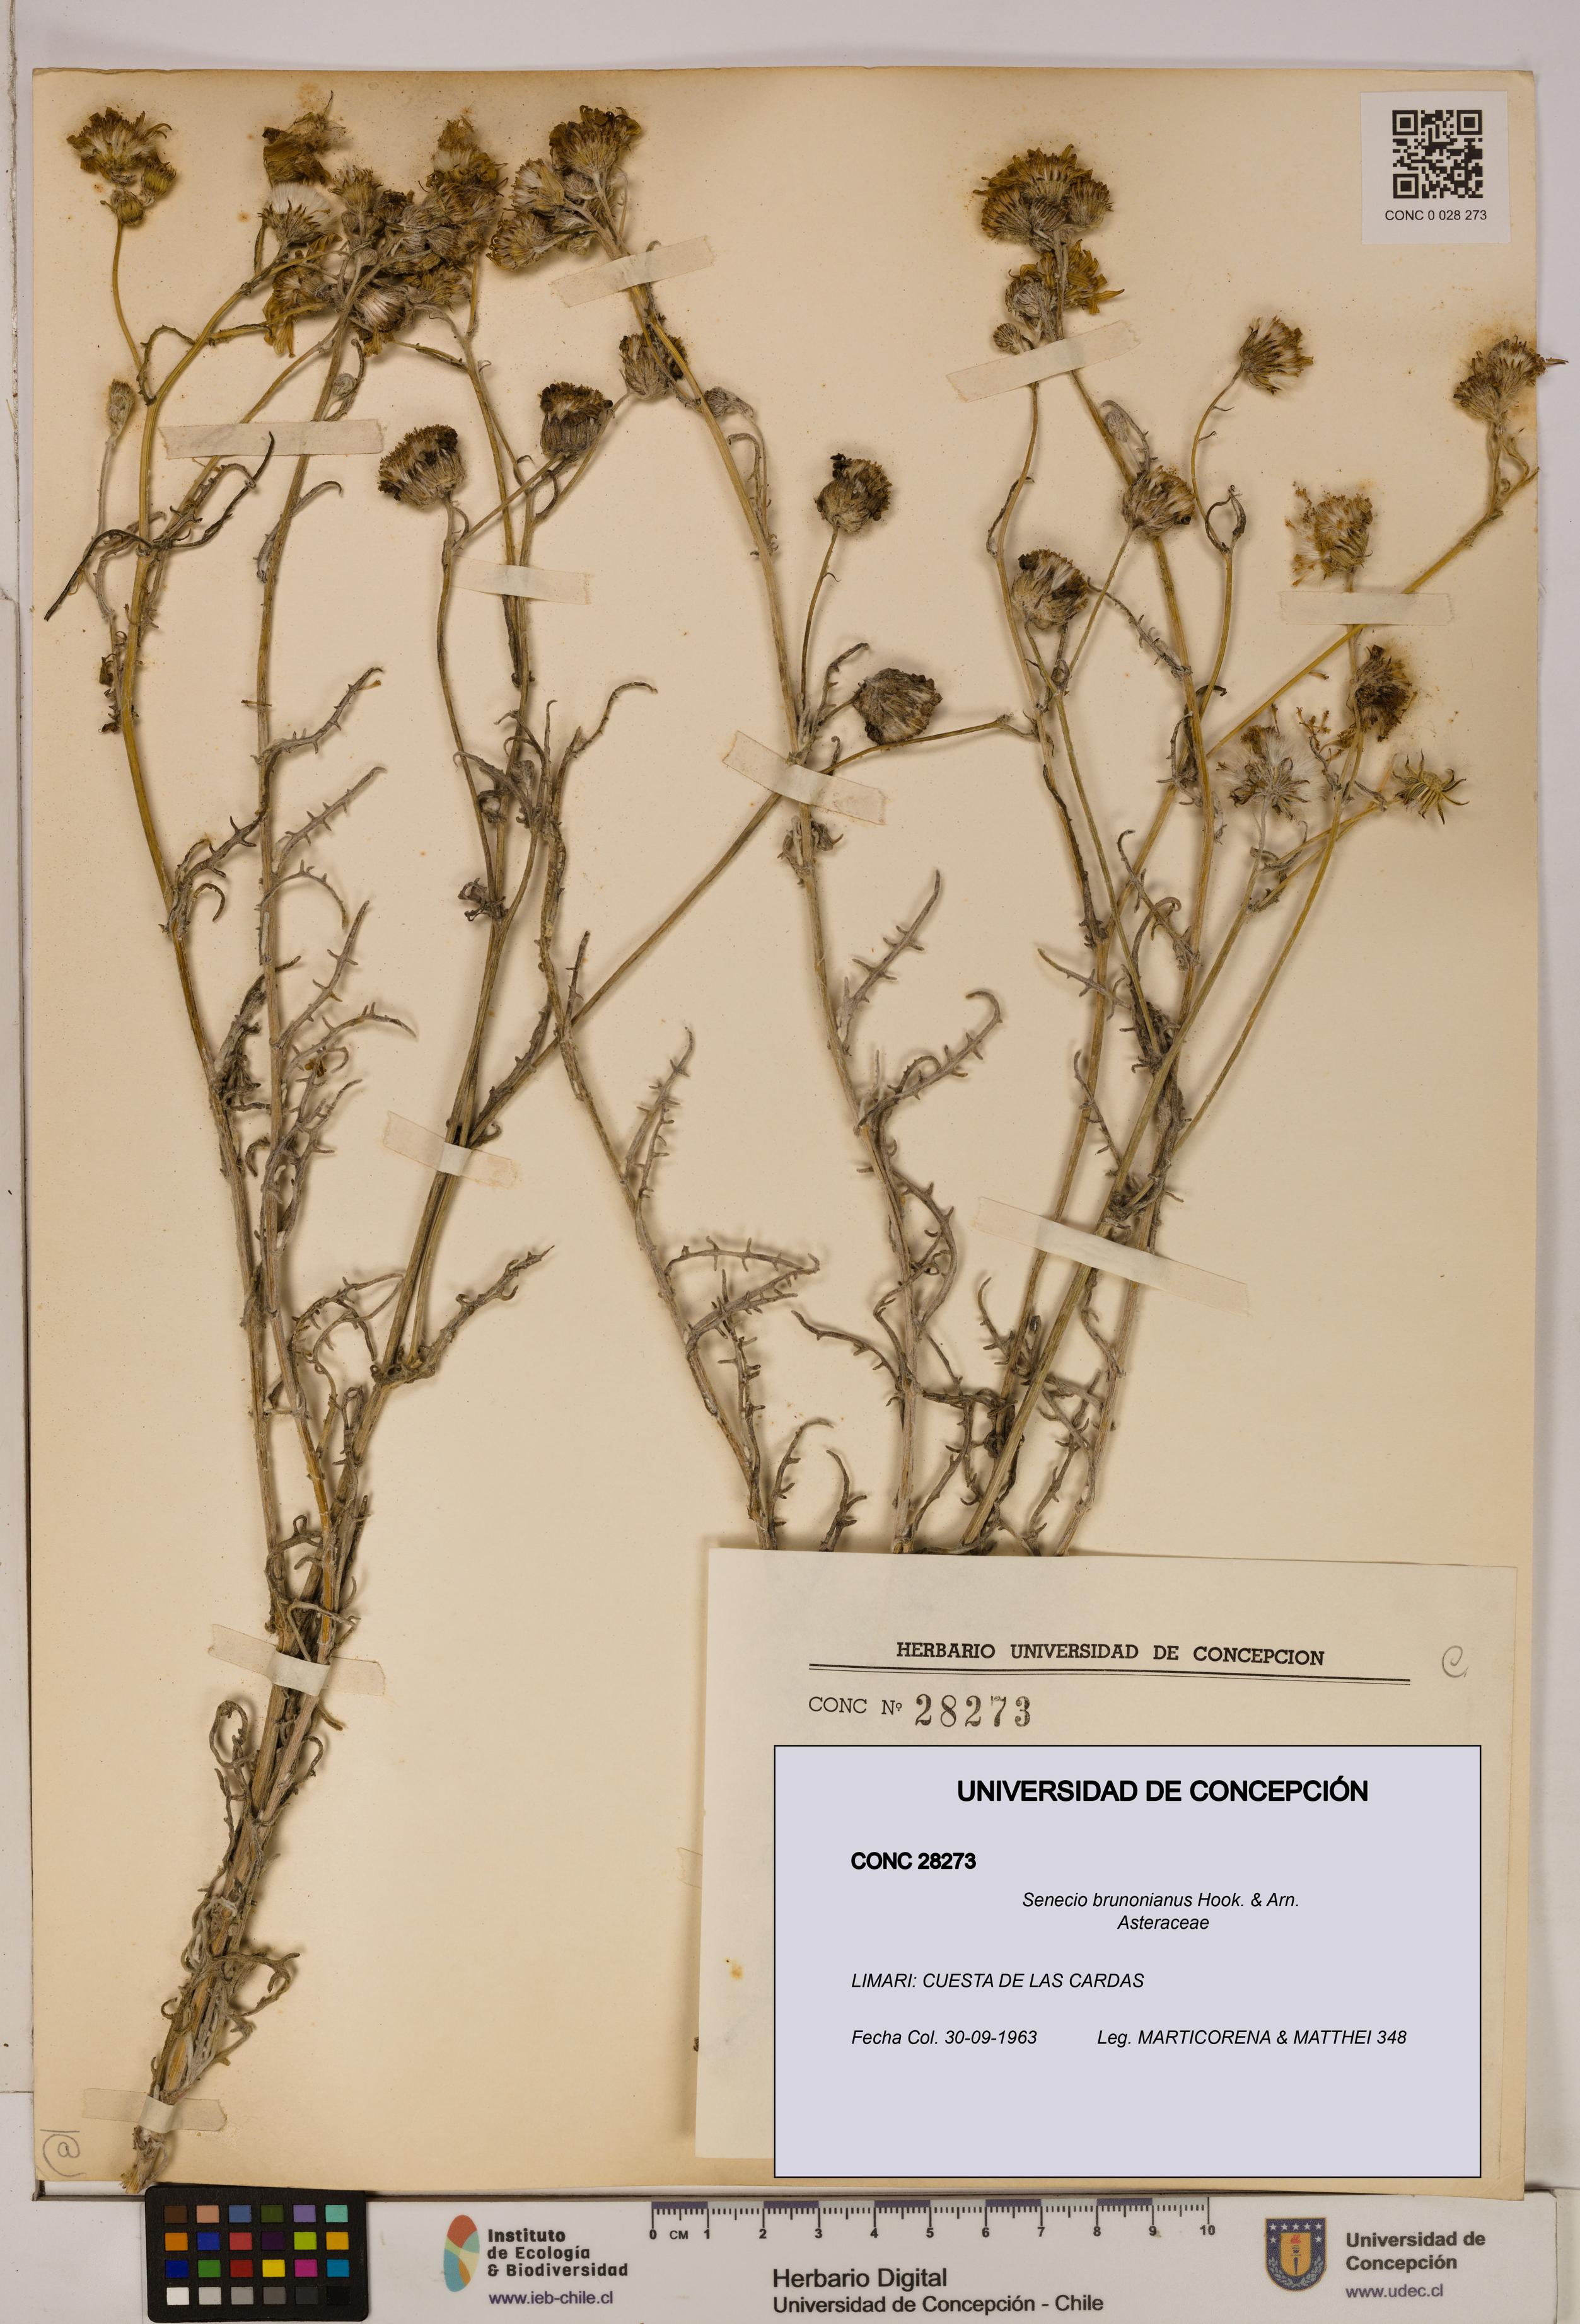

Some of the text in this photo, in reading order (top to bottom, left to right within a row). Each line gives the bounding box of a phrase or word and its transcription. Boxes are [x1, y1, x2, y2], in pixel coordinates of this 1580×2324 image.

[1385, 209, 1487, 221] CONC 0 028 273
[896, 1641, 1325, 1666] HERBARIO UNIVERSIDAD DE CONCEPCION
[808, 1696, 868, 1714] CONC
[915, 1694, 1031, 1728] 28273
[488, 2228, 566, 2243] Instituto
[649, 2224, 1216, 2240] 0 CM 1 2 3 4 5 6 7 8 9 10
[1346, 2231, 1486, 2248] Universidad de
[487, 2245, 590, 2262] de Ecología
[487, 2262, 628, 2277] & Biodiversidad
[1345, 2254, 1458, 2274] Concepción
[773, 2267, 947, 2292] Herbario Digital
[489, 2290, 613, 2304] www.ieb-chile.cl
[1345, 2283, 1443, 2298] www.udec.cl
[774, 2296, 886, 2313] Universidad
[892, 2296, 916, 2313] de
[922, 2295, 1035, 2316] Concepción
[1055, 2294, 1104, 2311] Chile
